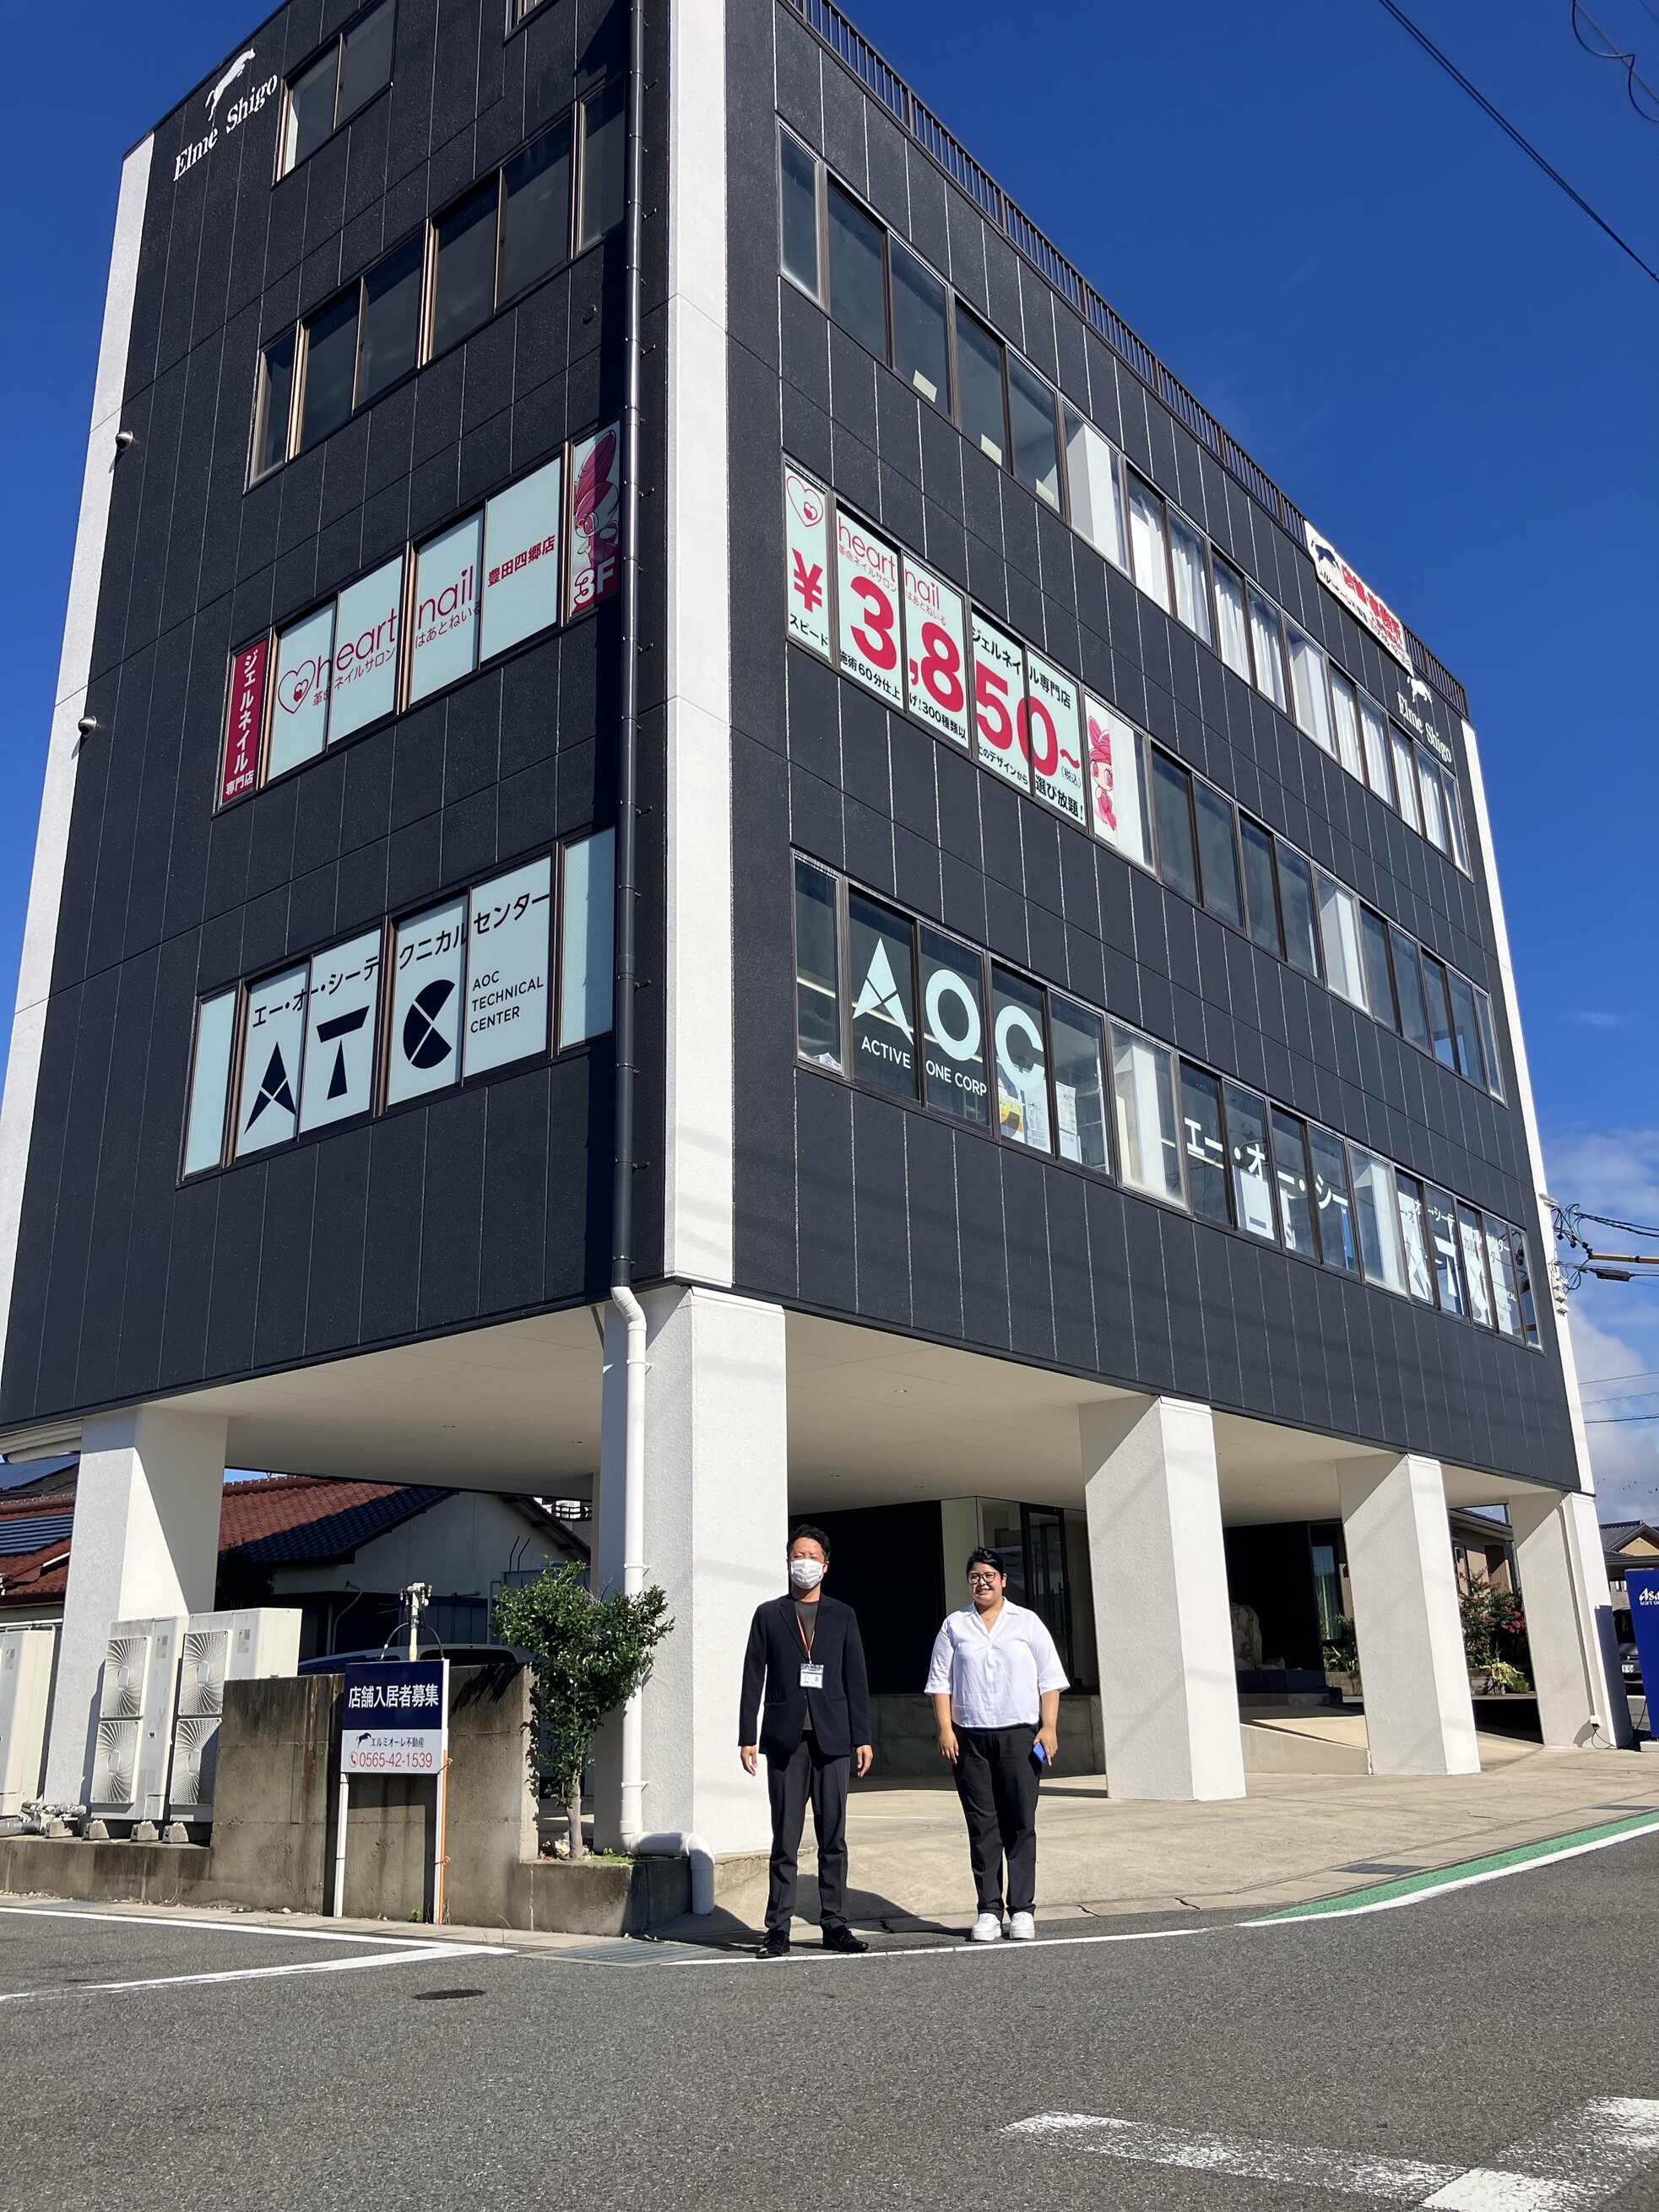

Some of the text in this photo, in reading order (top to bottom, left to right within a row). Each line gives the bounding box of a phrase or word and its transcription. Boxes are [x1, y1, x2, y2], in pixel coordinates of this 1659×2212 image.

[225, 74, 277, 134] Shigo
[574, 556, 615, 605] 3F
[837, 516, 941, 610] heart nail
[315, 564, 474, 691] heart nail
[233, 649, 258, 774] ジェルネイル
[1396, 691, 1452, 763] Elme Shigo
[225, 770, 254, 795] 専門店
[471, 976, 544, 1012] TECHNICAL
[472, 970, 500, 991] AOC
[469, 1006, 520, 1033] CENTER
[853, 937, 1046, 1083] AOC
[861, 1034, 988, 1097] ACTIVE ONE CORP
[348, 1683, 439, 1708] 店舗入居者募集
[359, 1752, 432, 1767] 0565-42-1539
[371, 1737, 425, 1748] エルミオーレ不動産
